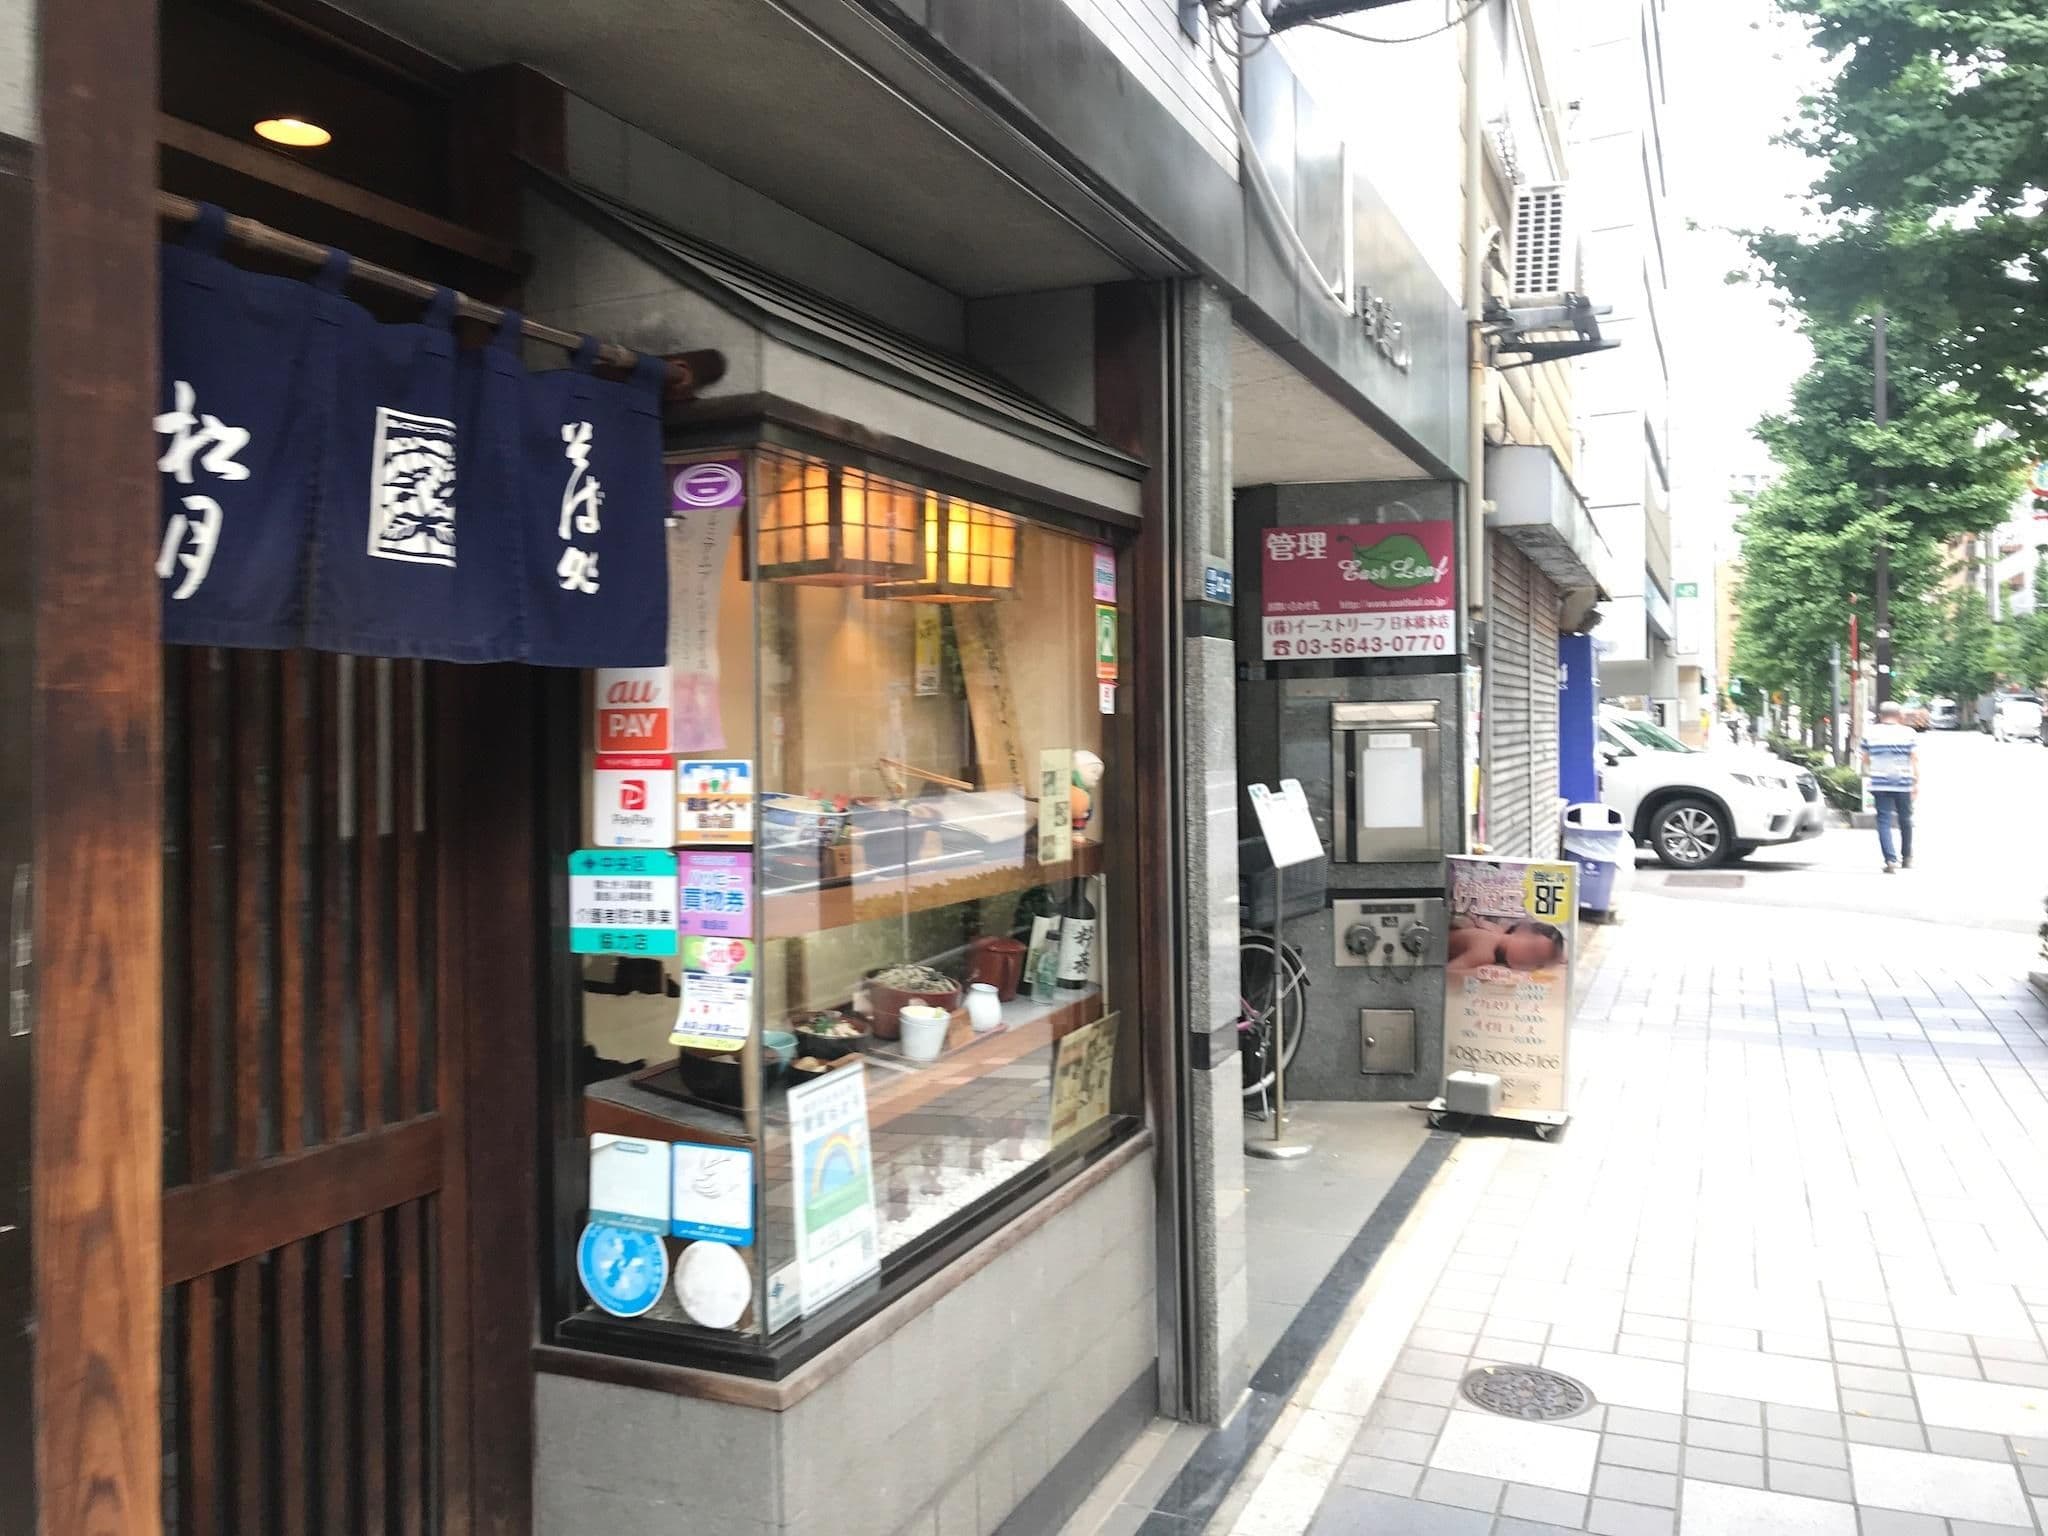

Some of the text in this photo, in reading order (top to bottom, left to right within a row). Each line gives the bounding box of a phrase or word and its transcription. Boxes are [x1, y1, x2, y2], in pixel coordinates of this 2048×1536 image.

[1266, 531, 1328, 561] 管理
[1338, 555, 1449, 583] East Leaf
[1296, 634, 1446, 655] 03-5643-0770
[607, 680, 659, 704] au
[608, 713, 659, 739] PAY
[612, 814, 655, 826] PayPay
[601, 855, 647, 872] 中央区
[1535, 885, 1565, 915] 8F
